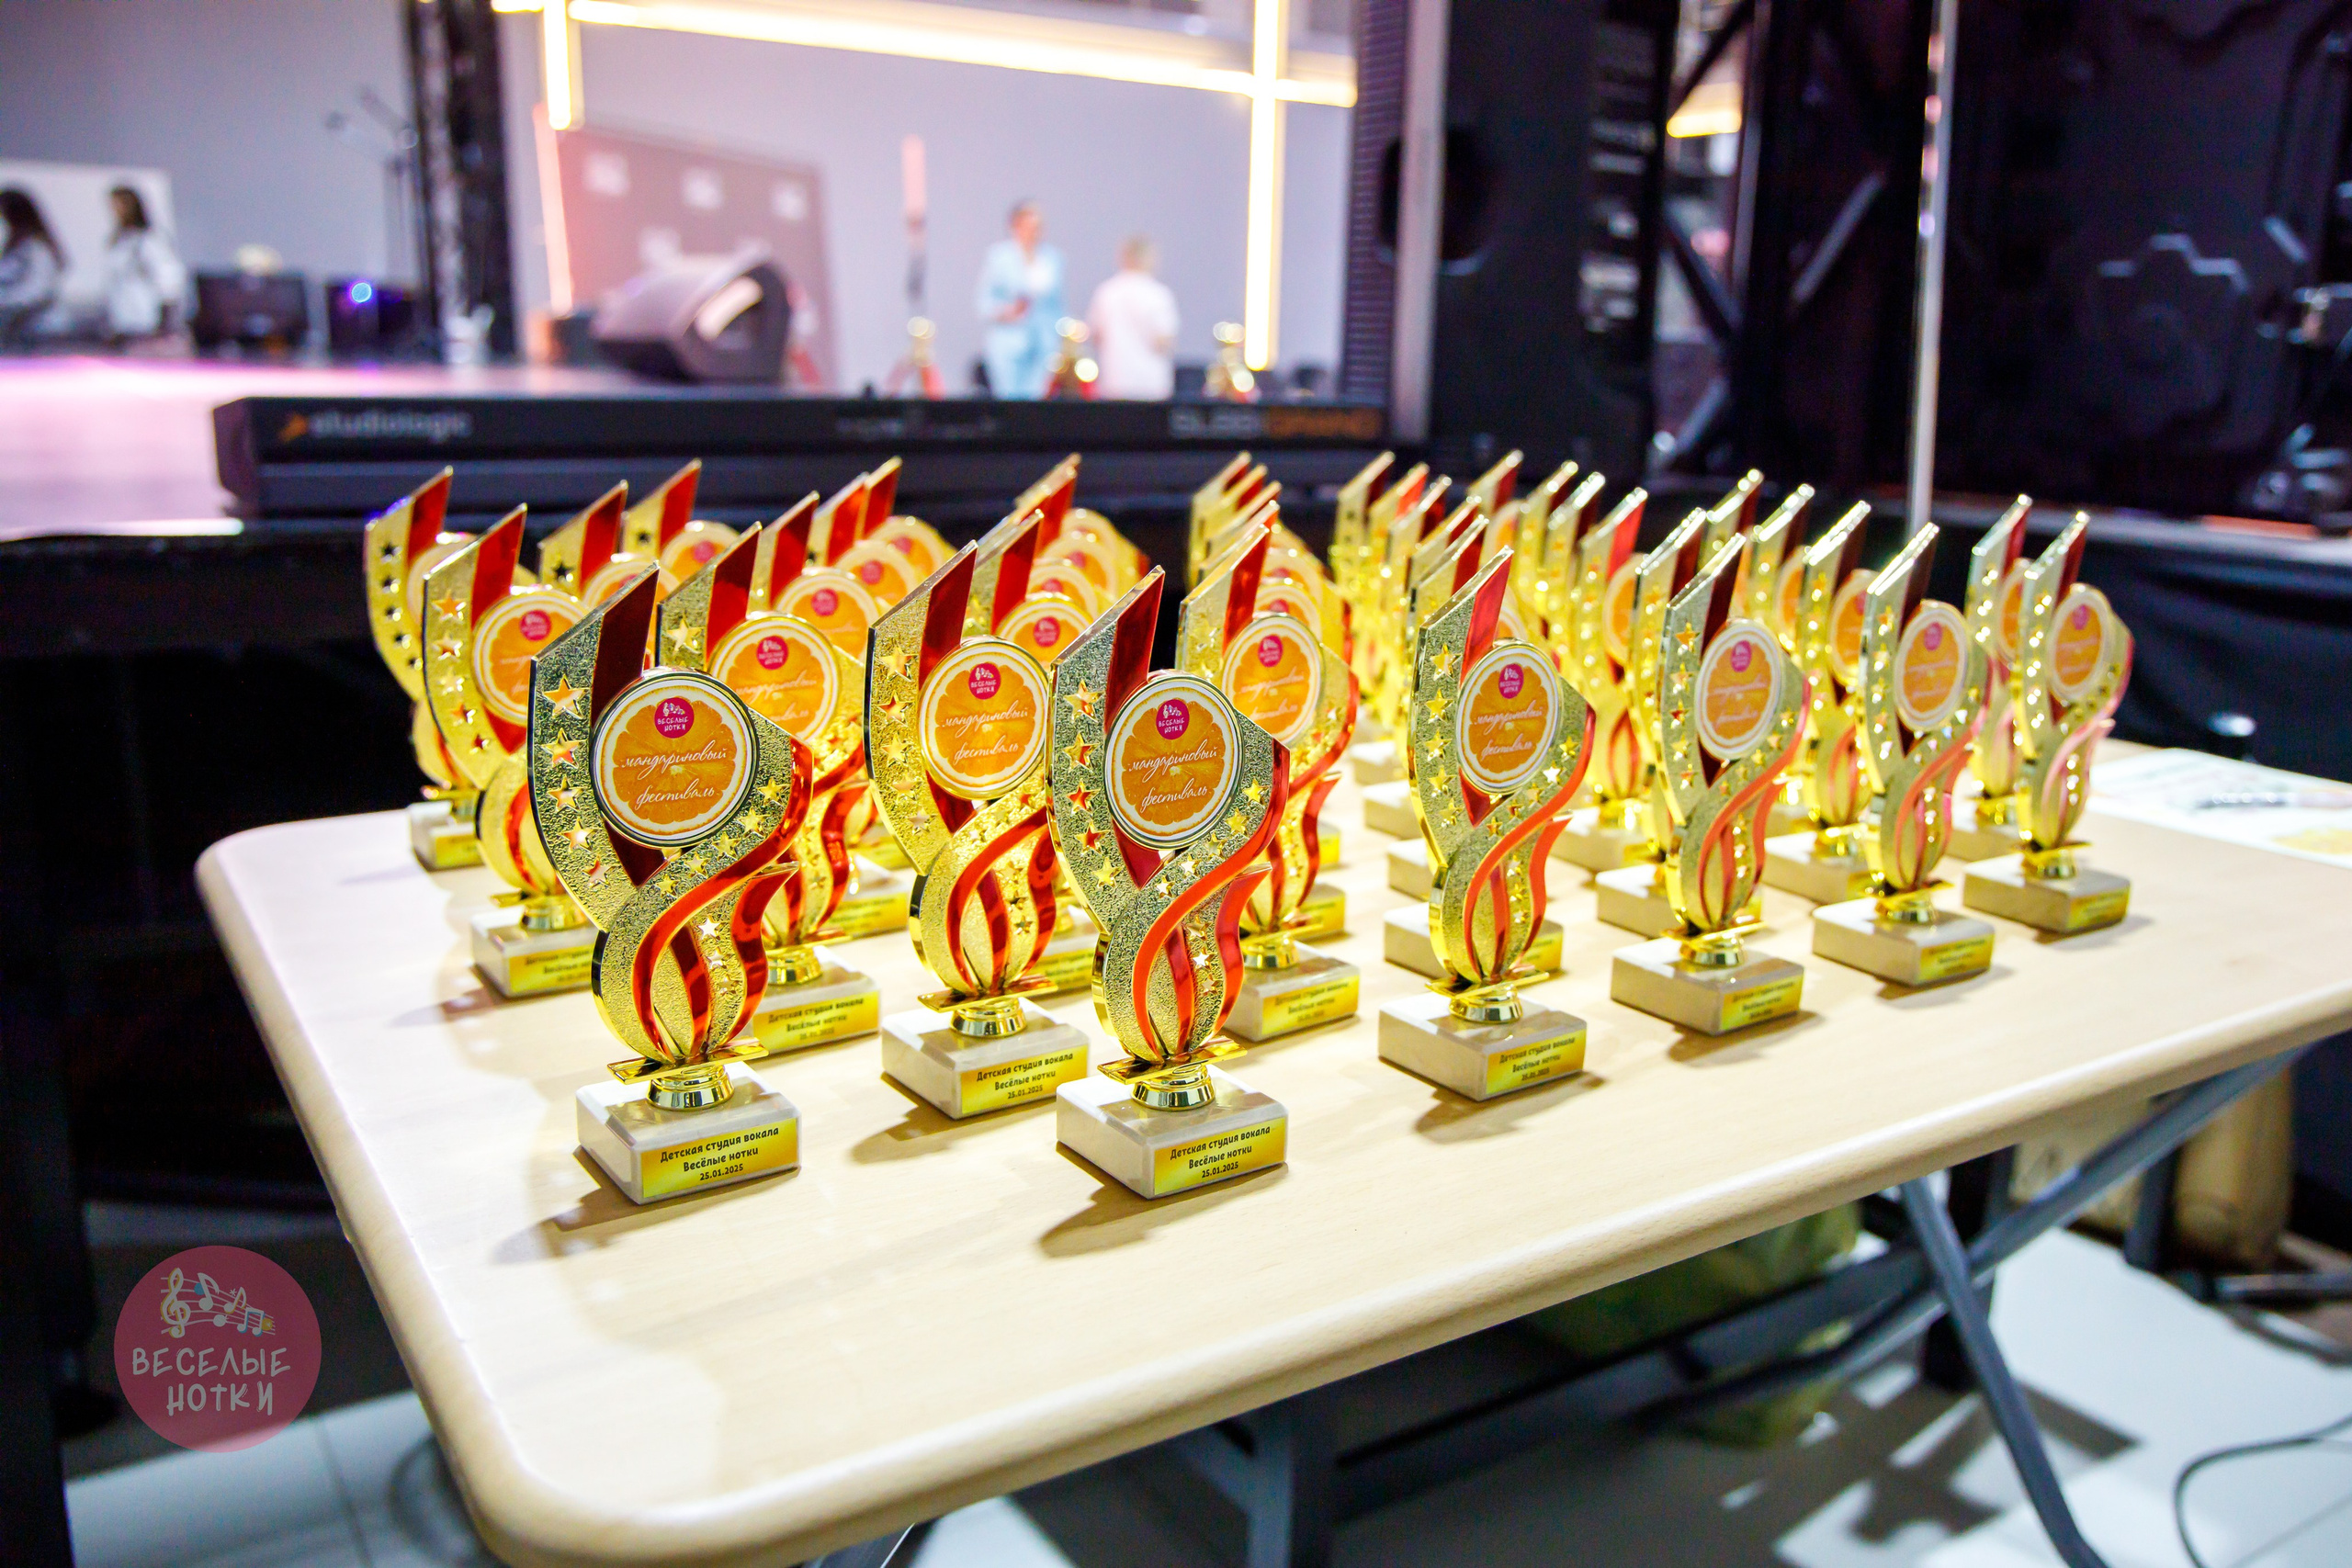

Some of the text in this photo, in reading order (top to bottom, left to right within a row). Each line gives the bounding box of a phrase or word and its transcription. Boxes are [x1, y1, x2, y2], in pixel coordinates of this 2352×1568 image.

[658, 716, 689, 726] ВЕСЕЛЫЕ
[664, 724, 685, 732] НОТКИ
[943, 700, 1028, 739] мандариновый
[1159, 718, 1185, 728] ВЕСЕЛЫЕ
[1165, 726, 1183, 735] НОТКИ
[621, 739, 727, 780] мандариновый
[954, 735, 1018, 766] фестиваль
[1129, 739, 1216, 783] мандариновый
[634, 779, 715, 810] фестиваль
[1140, 778, 1208, 814] фестиваль
[976, 1053, 1073, 1082] Детская студия вокала
[995, 1071, 1057, 1090] Весёлые нотки
[660, 1127, 779, 1163] Детская студия вокала
[1170, 1126, 1270, 1161] Детская студия вокала
[1189, 1145, 1252, 1169] Весёлые нотки
[684, 1147, 759, 1172] Весёлые нотки
[700, 1163, 744, 1181] 25.01.2025
[1202, 1161, 1238, 1178] 25.01.2025
